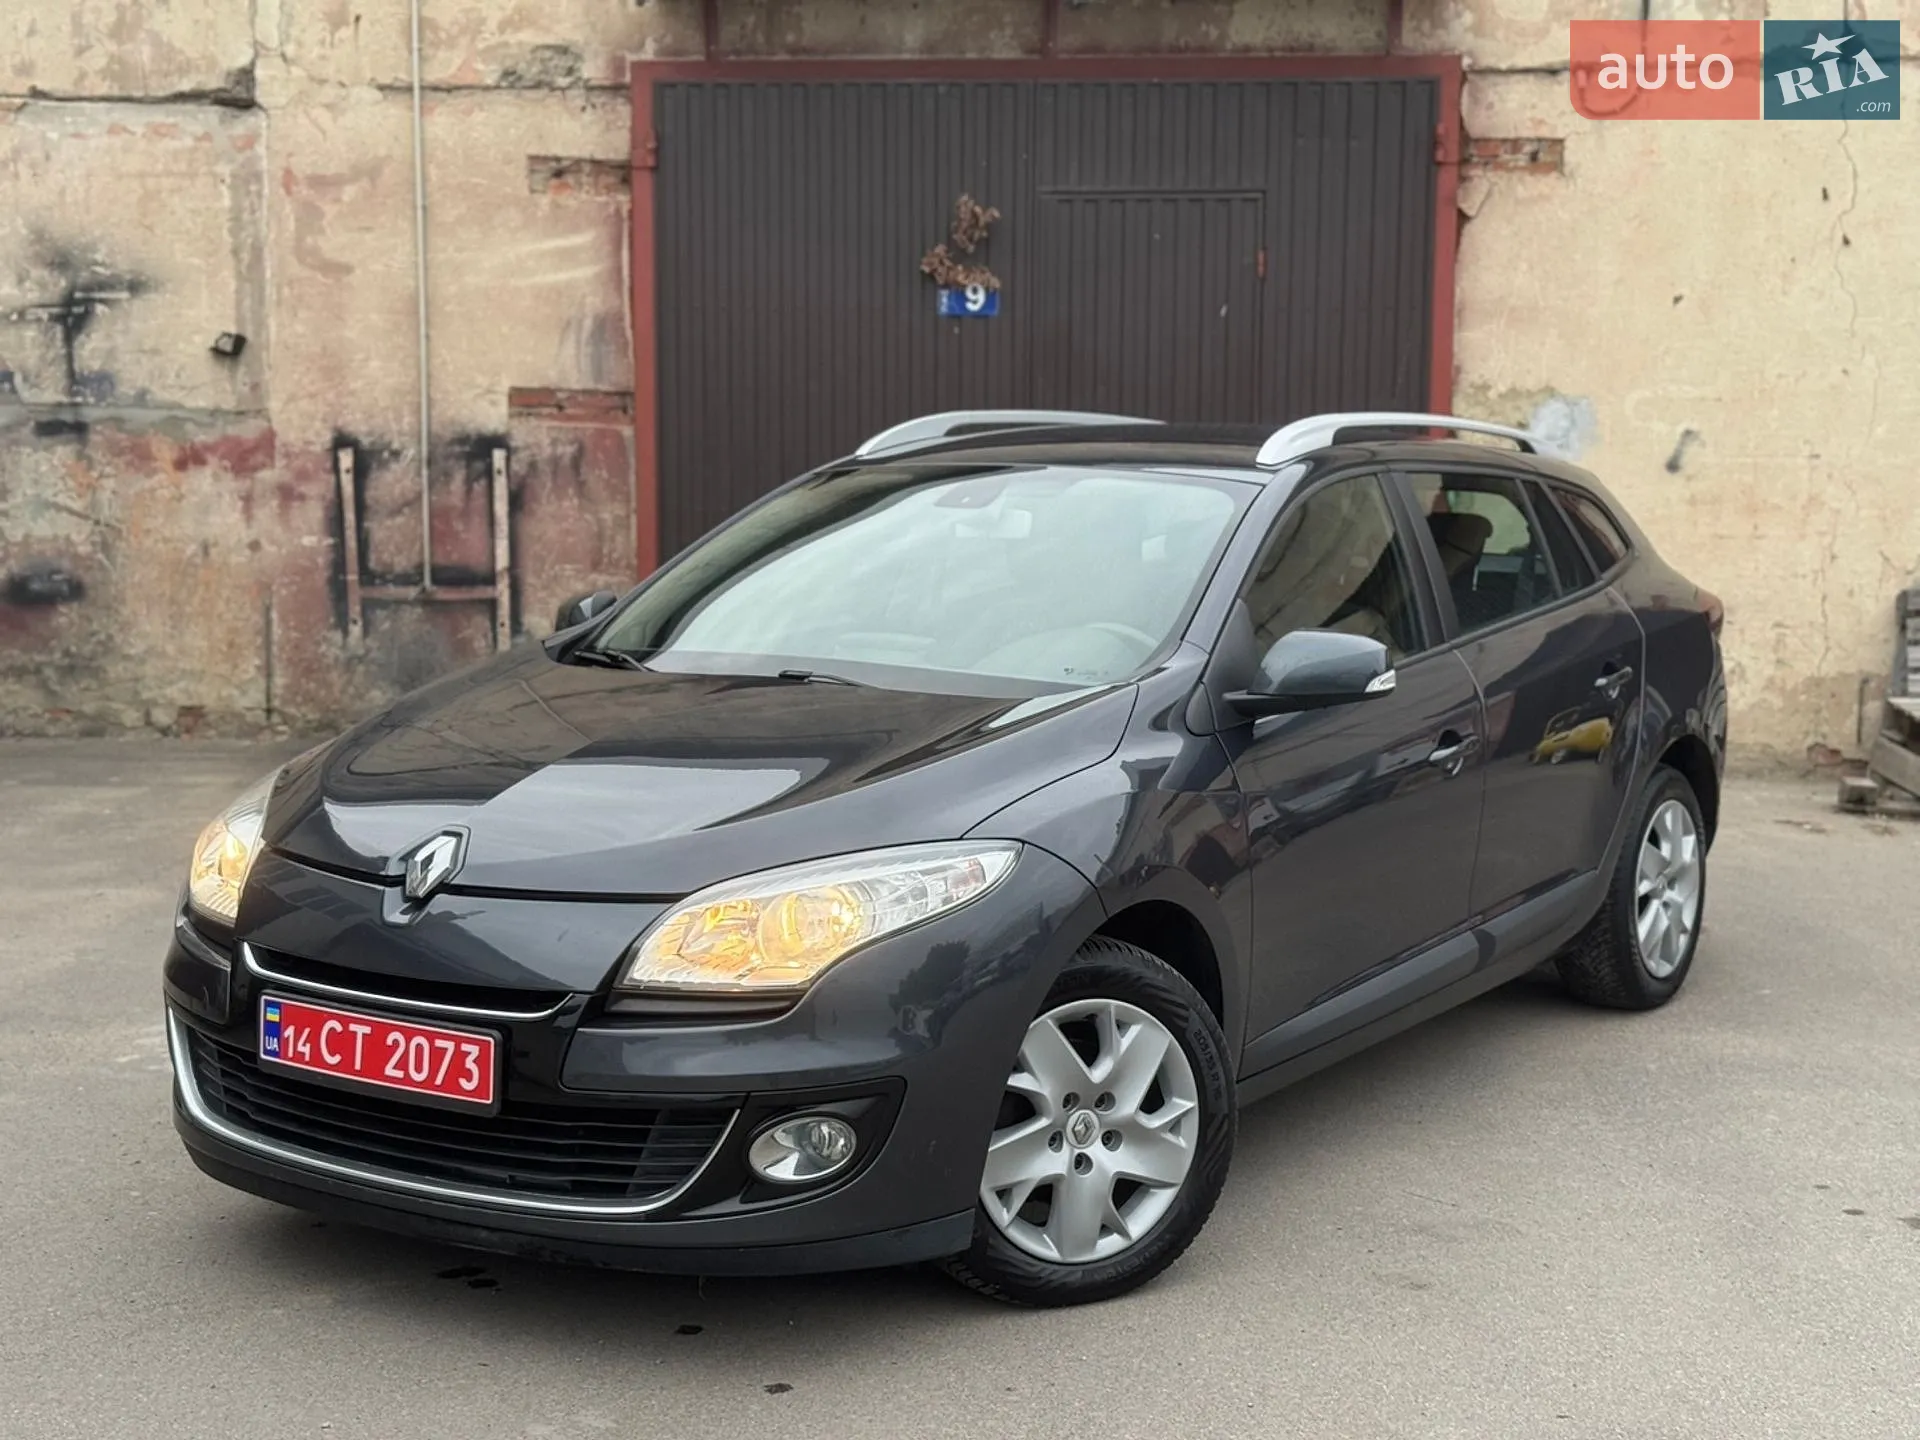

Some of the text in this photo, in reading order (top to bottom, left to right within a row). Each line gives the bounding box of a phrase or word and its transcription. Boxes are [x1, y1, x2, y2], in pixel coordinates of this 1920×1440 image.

[965, 282, 986, 312] 9
[265, 1035, 279, 1052] UA
[384, 1031, 480, 1092] 2073
